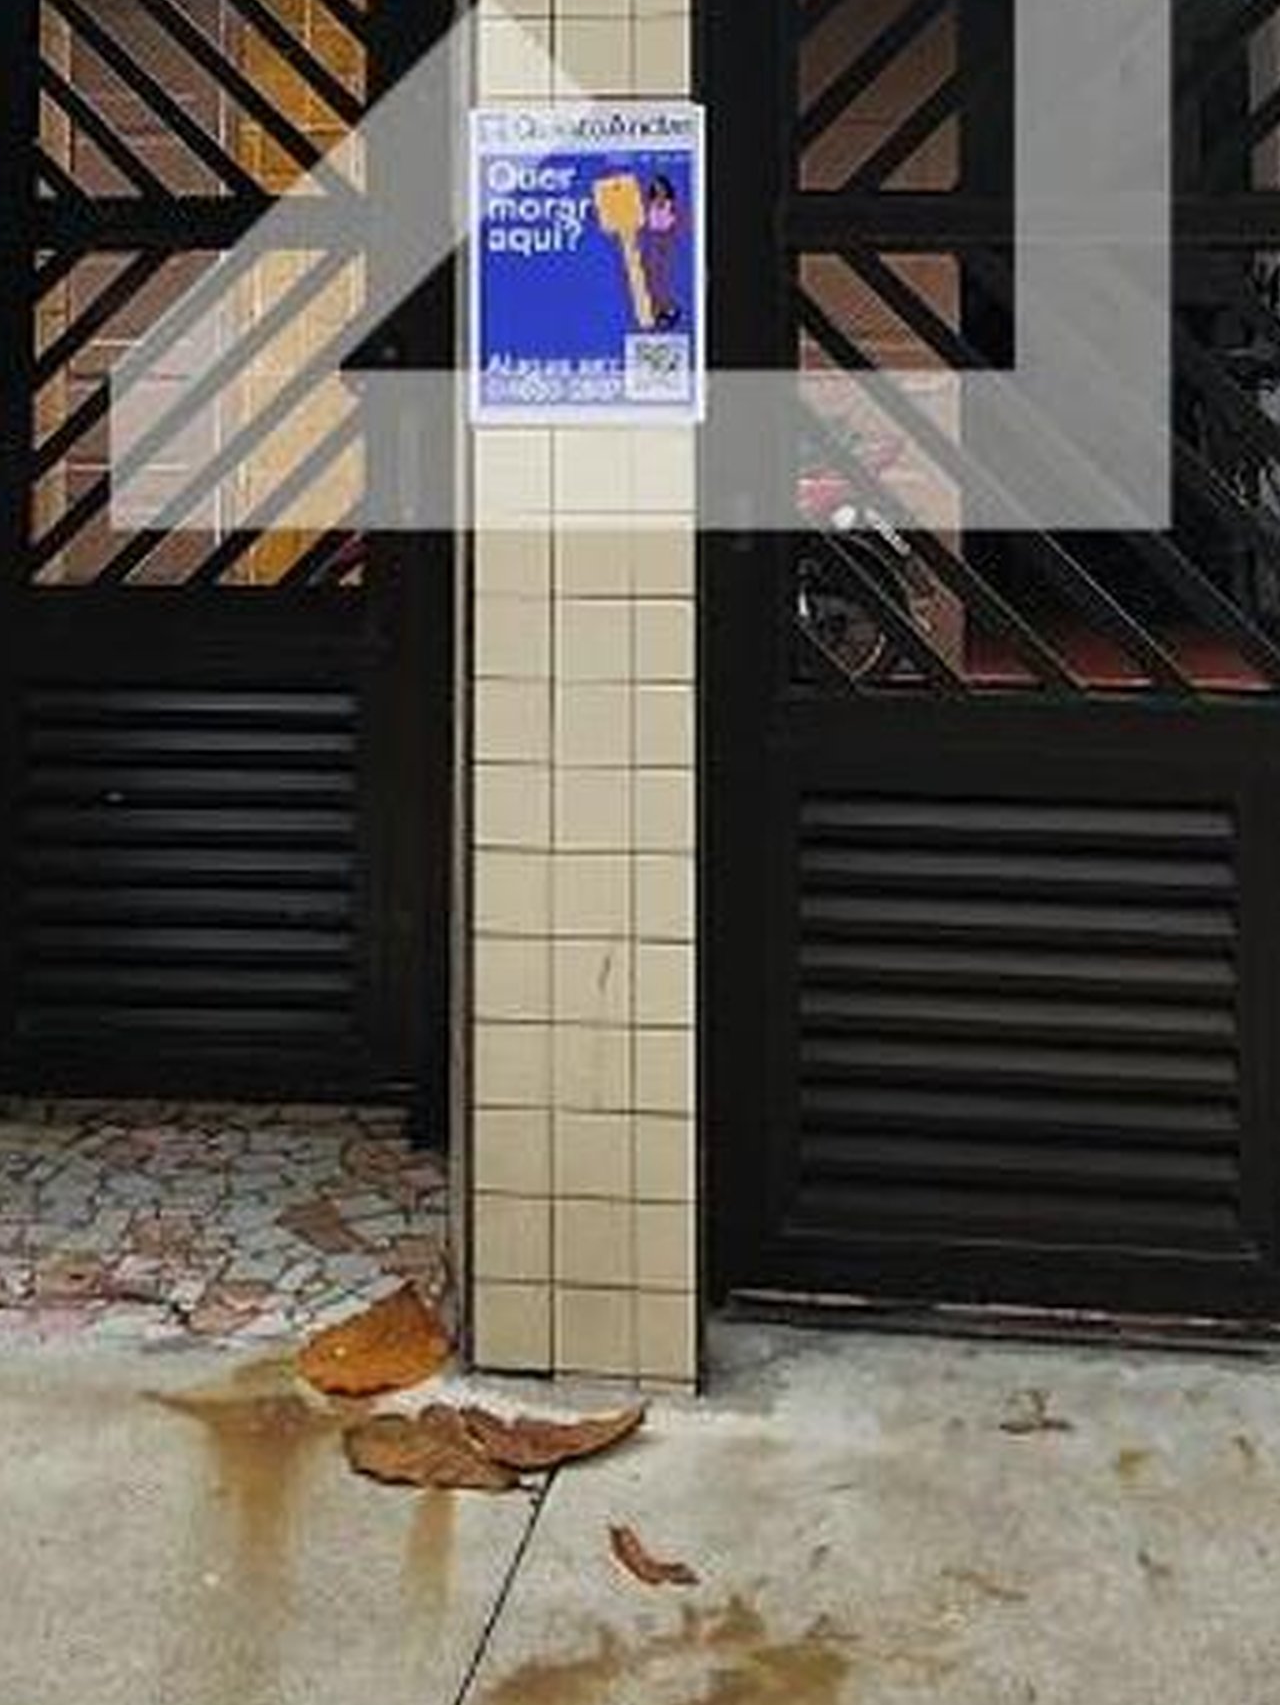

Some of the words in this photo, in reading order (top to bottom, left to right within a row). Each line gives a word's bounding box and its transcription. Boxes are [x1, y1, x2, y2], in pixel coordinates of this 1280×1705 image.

[488, 160, 577, 192] Quer
[488, 196, 592, 222] morar
[488, 220, 581, 257] aqui?
